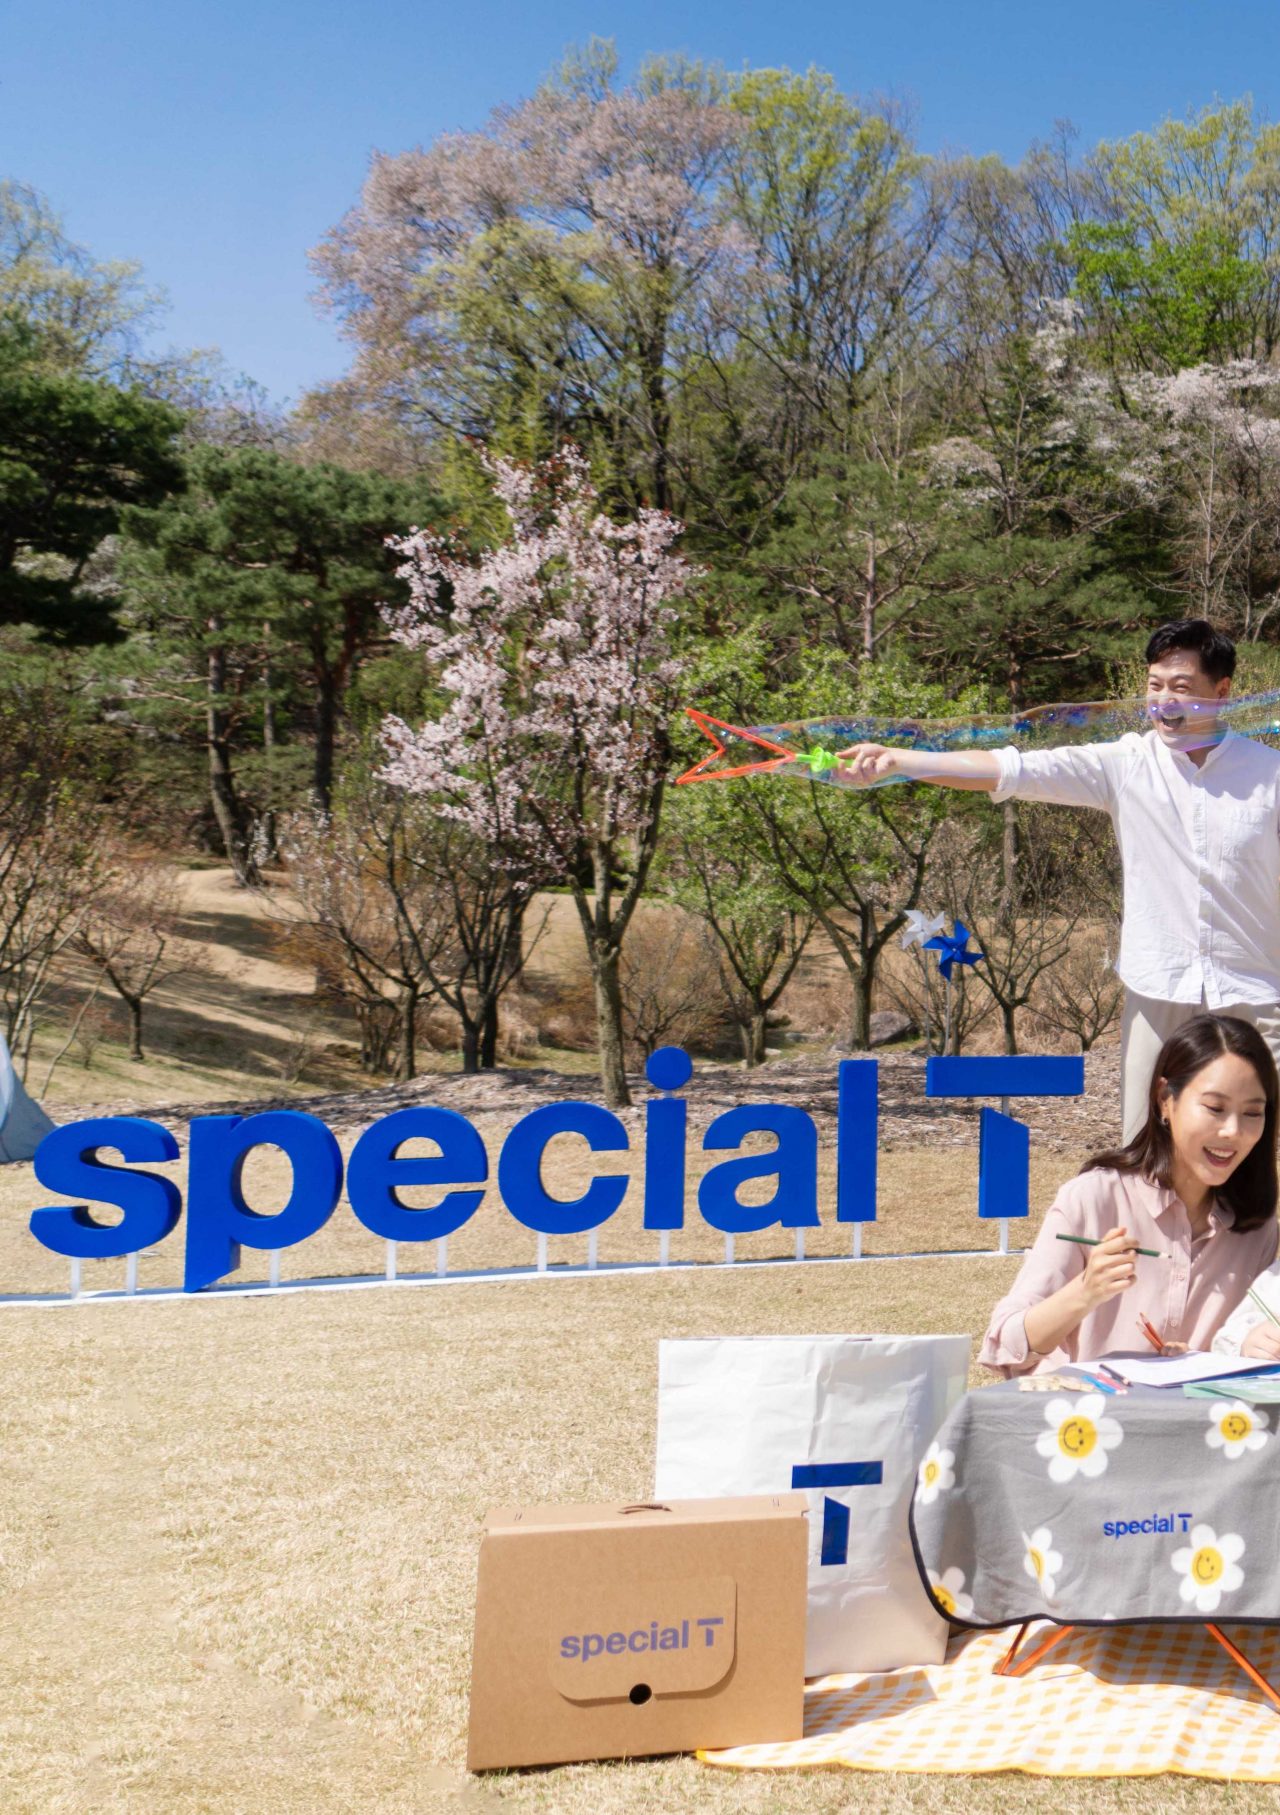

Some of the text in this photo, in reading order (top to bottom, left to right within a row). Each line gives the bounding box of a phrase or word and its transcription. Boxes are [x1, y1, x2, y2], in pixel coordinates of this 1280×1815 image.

[29, 1046, 1085, 1293] special T
[791, 1460, 883, 1566] T
[1103, 1513, 1193, 1539] special T
[560, 1617, 724, 1662] special T
